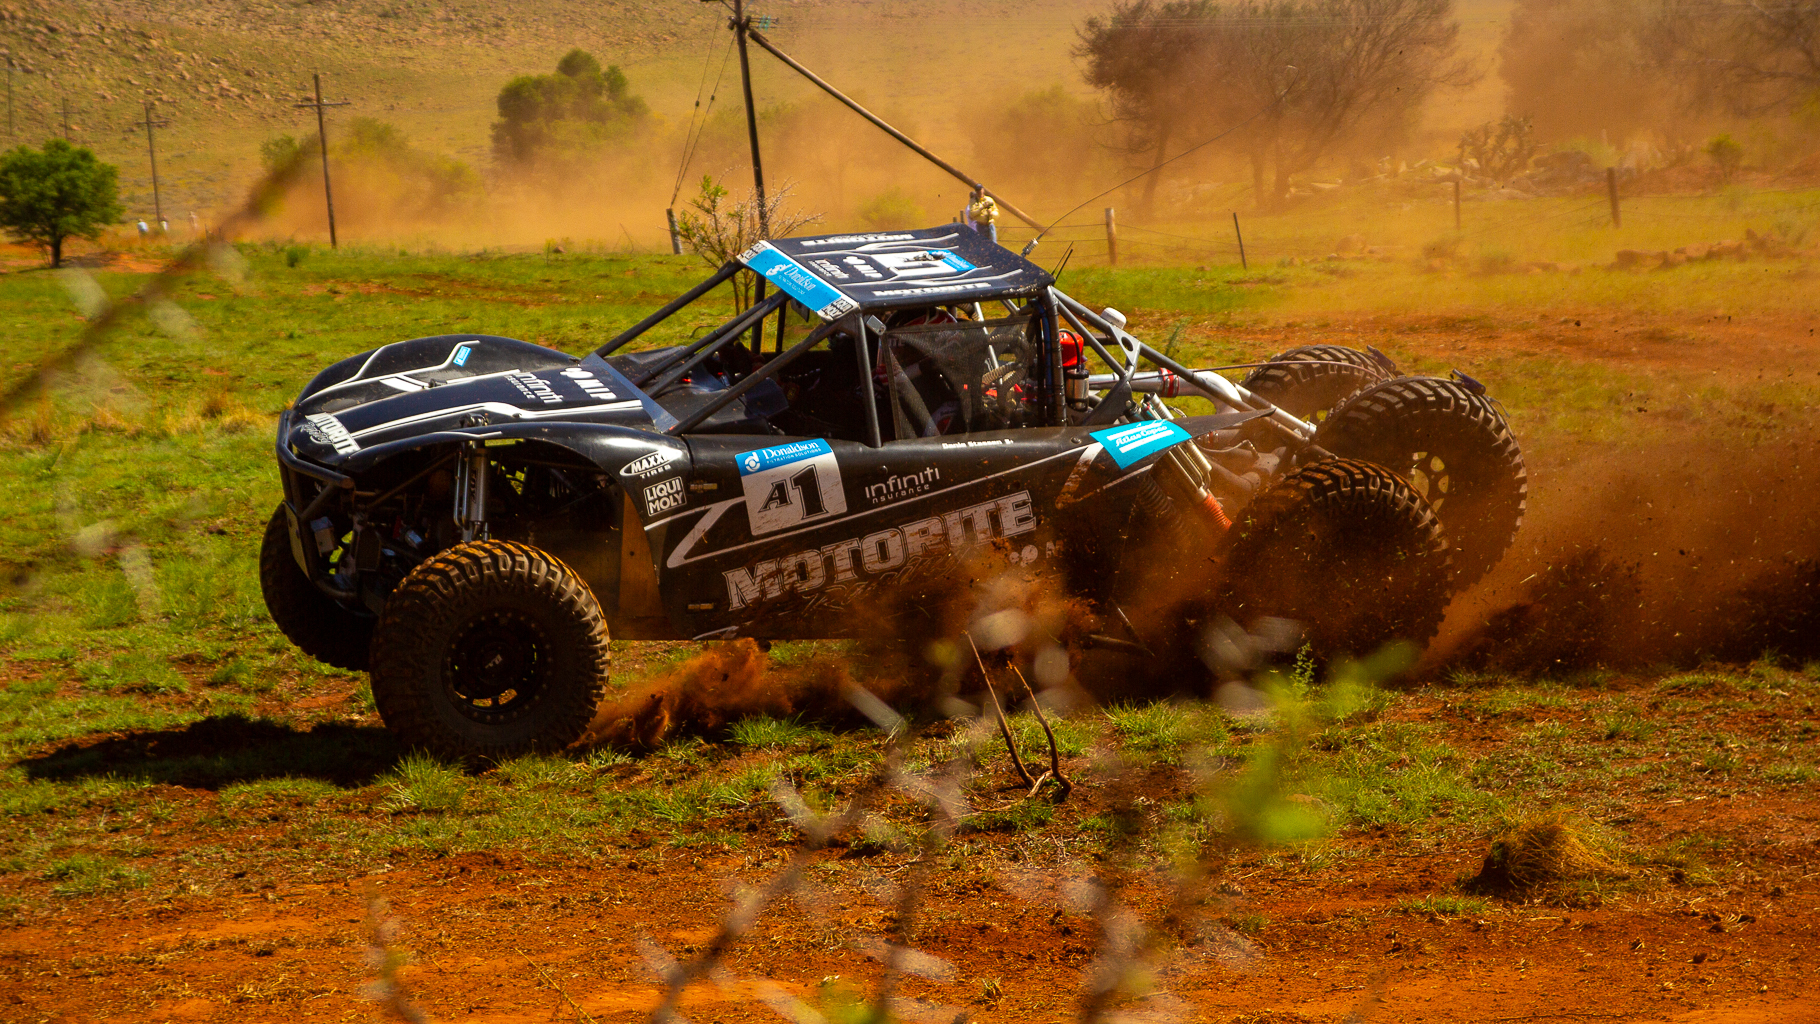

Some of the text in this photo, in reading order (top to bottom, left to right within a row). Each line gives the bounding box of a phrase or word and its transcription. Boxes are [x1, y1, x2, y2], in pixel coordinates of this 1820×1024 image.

[1115, 425, 1168, 448] Atlas Copco
[762, 441, 820, 460] Donaldson
[640, 463, 672, 479] TIRES
[865, 466, 940, 499] infiniti
[646, 478, 682, 501] LIQUI
[758, 463, 830, 521] A1
[649, 491, 684, 514] MOLY
[722, 489, 1037, 612] MOTORITE
